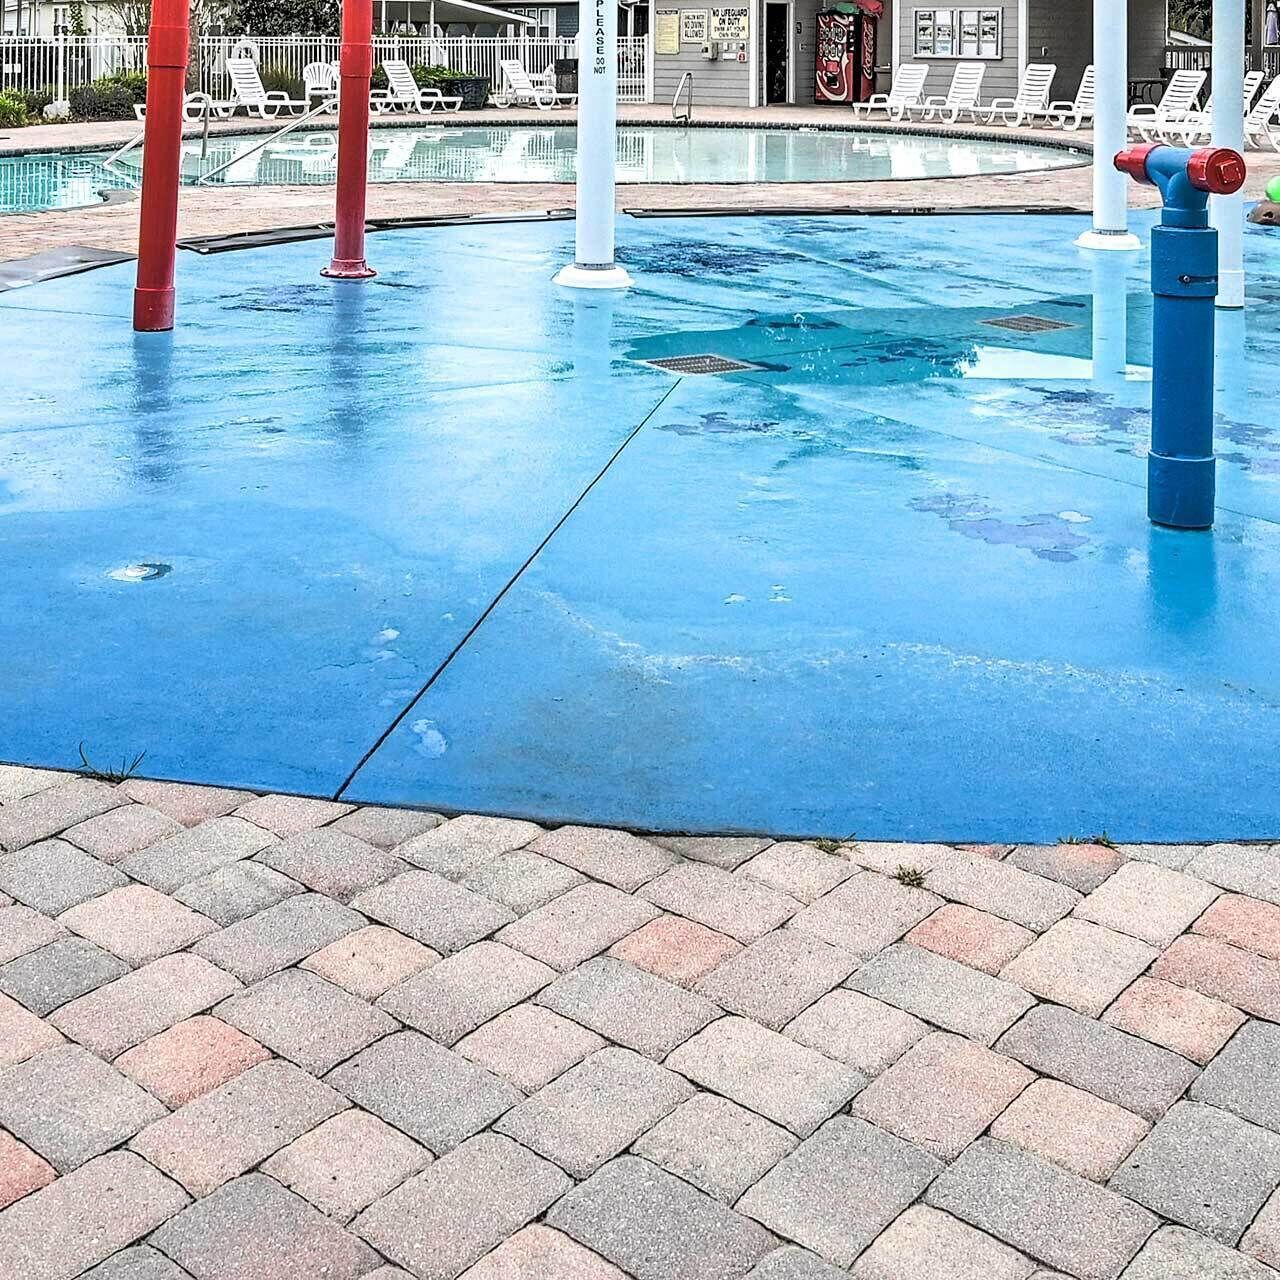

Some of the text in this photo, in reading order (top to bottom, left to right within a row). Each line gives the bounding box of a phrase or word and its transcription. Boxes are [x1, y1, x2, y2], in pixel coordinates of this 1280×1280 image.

[712, 9, 719, 17] NO
[721, 9, 748, 17] LIFEGUARD
[595, 0, 605, 55] PLEASE
[684, 30, 704, 38] ALLOWED
[596, 57, 605, 65] DO
[593, 66, 606, 74] NOT
